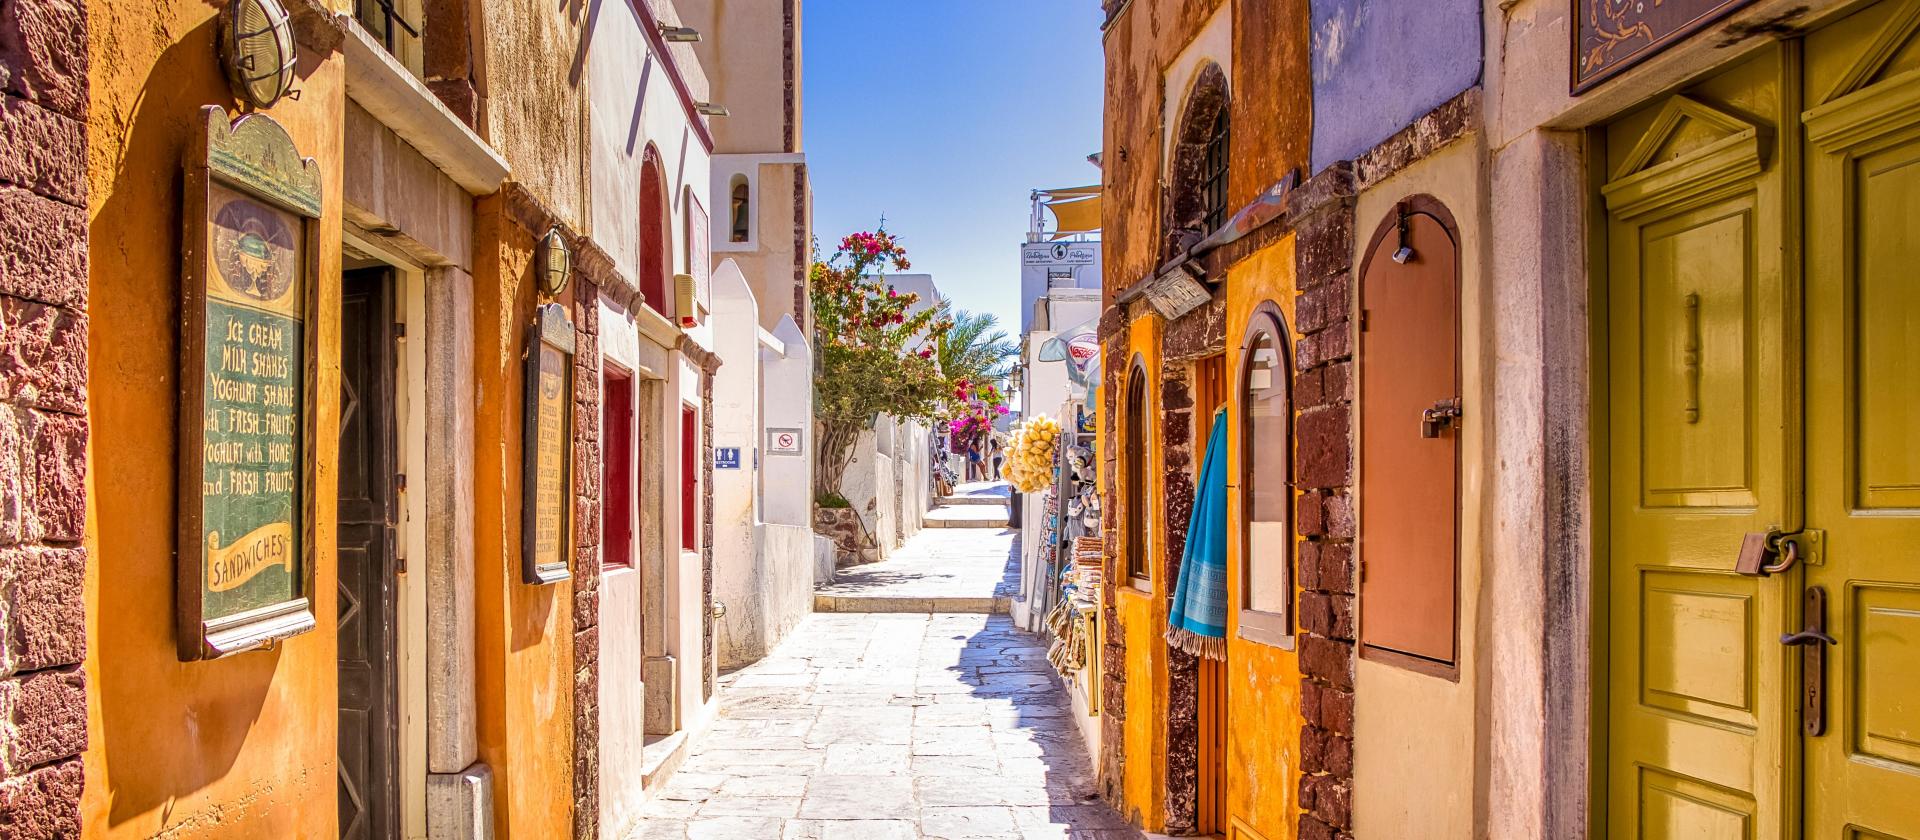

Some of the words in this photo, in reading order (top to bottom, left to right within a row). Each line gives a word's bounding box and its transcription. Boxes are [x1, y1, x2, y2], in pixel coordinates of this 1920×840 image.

[226, 316, 244, 343] ICE
[249, 323, 282, 351] CREAM
[221, 344, 247, 374] MILK
[251, 352, 288, 379] SHAKES
[211, 372, 257, 403] YOGHURT
[229, 408, 259, 436] FRESH
[265, 413, 296, 436] FRUITS
[204, 438, 243, 464] YOGHURT
[246, 442, 263, 463] with
[268, 442, 295, 465] HONEY
[204, 469, 222, 496] and
[230, 470, 259, 496] FRESH
[265, 471, 295, 494] FRUITS
[213, 534, 283, 587] SANDWICHES
